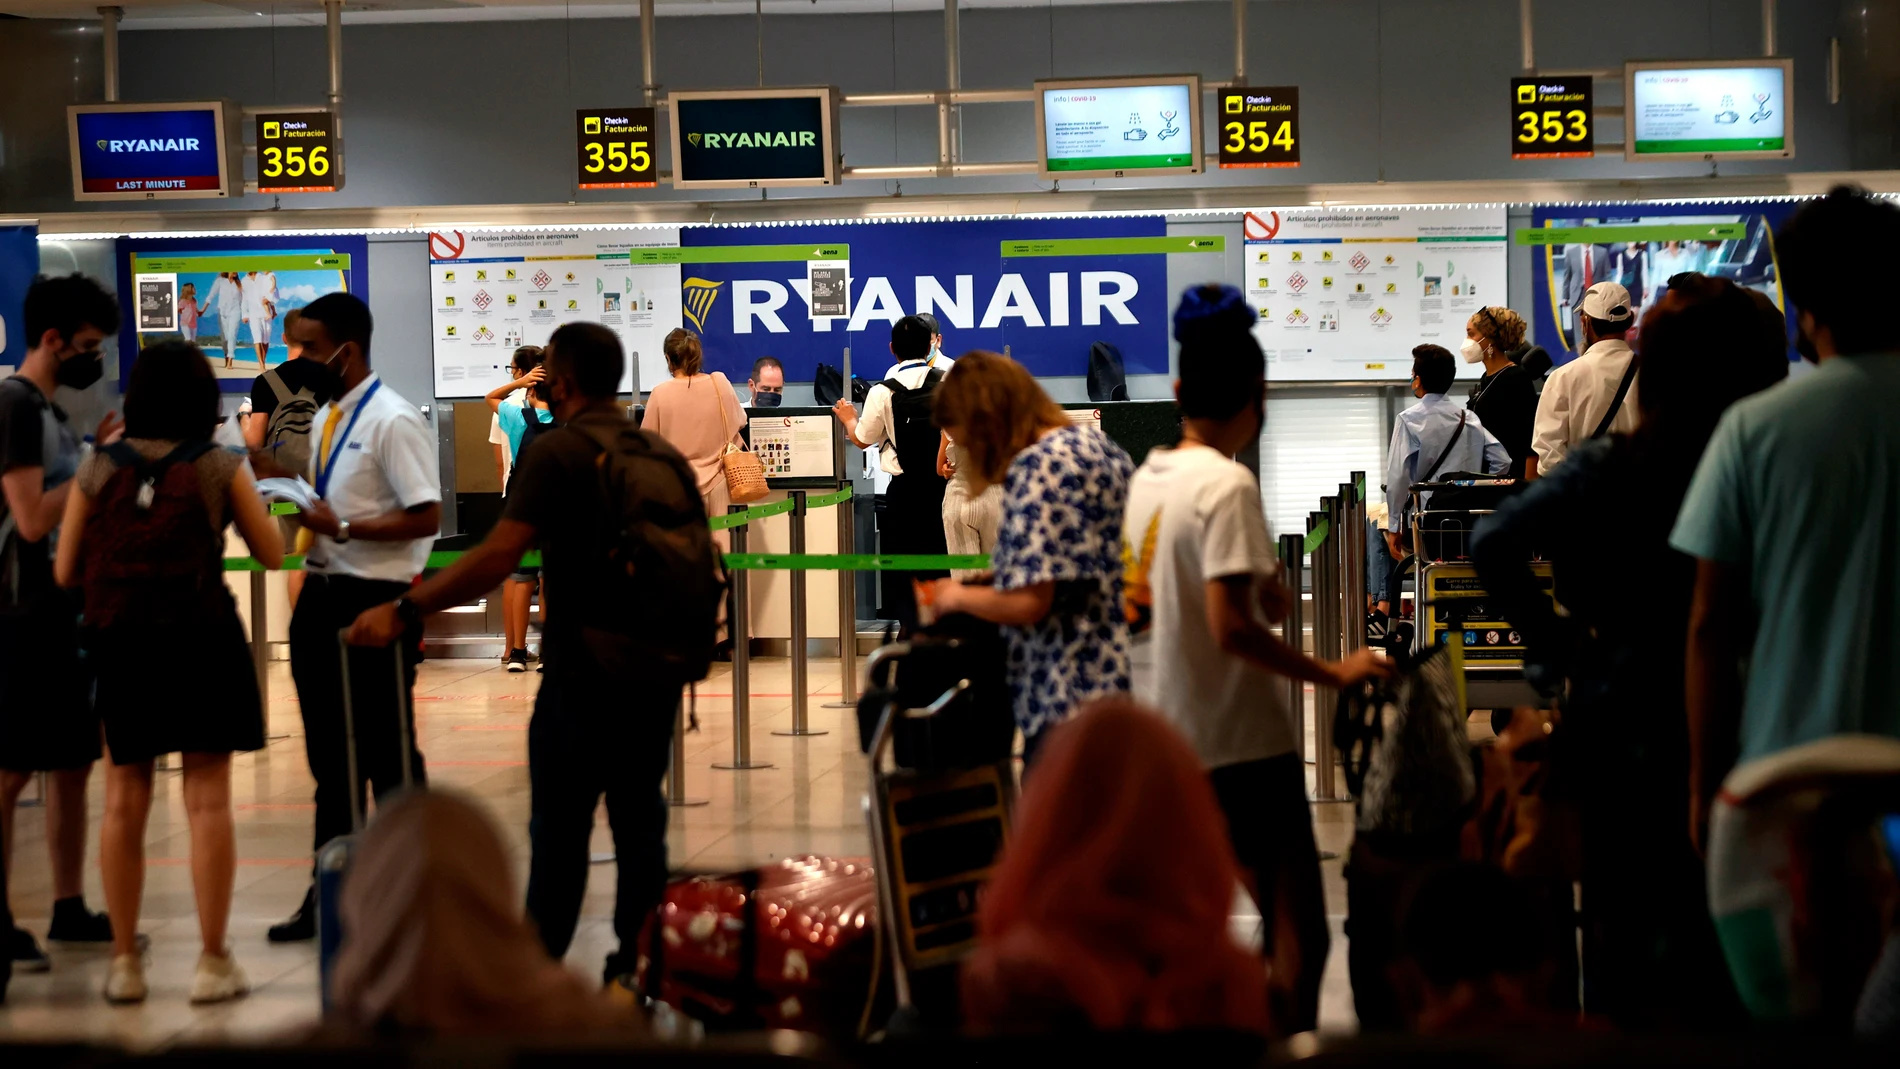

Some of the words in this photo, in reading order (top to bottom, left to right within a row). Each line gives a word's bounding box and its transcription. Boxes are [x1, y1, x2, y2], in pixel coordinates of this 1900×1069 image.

[1539, 92, 1585, 102] Facturación
[1247, 103, 1291, 112] Facturación
[283, 121, 307, 129] Check-in
[604, 117, 628, 125] Check-in
[1517, 109, 1587, 143] 353
[283, 129, 326, 138] Facturación
[605, 124, 647, 133] Facturación
[704, 131, 816, 149] RYANAIR
[1224, 120, 1294, 153] 354
[110, 138, 199, 152] RYANAIR
[263, 146, 329, 177] 356
[584, 141, 650, 173] 355
[116, 181, 143, 189] LAST
[146, 180, 186, 188] MINUTE
[501, 234, 535, 242] prohibidos
[732, 271, 1139, 333] RANAIR
